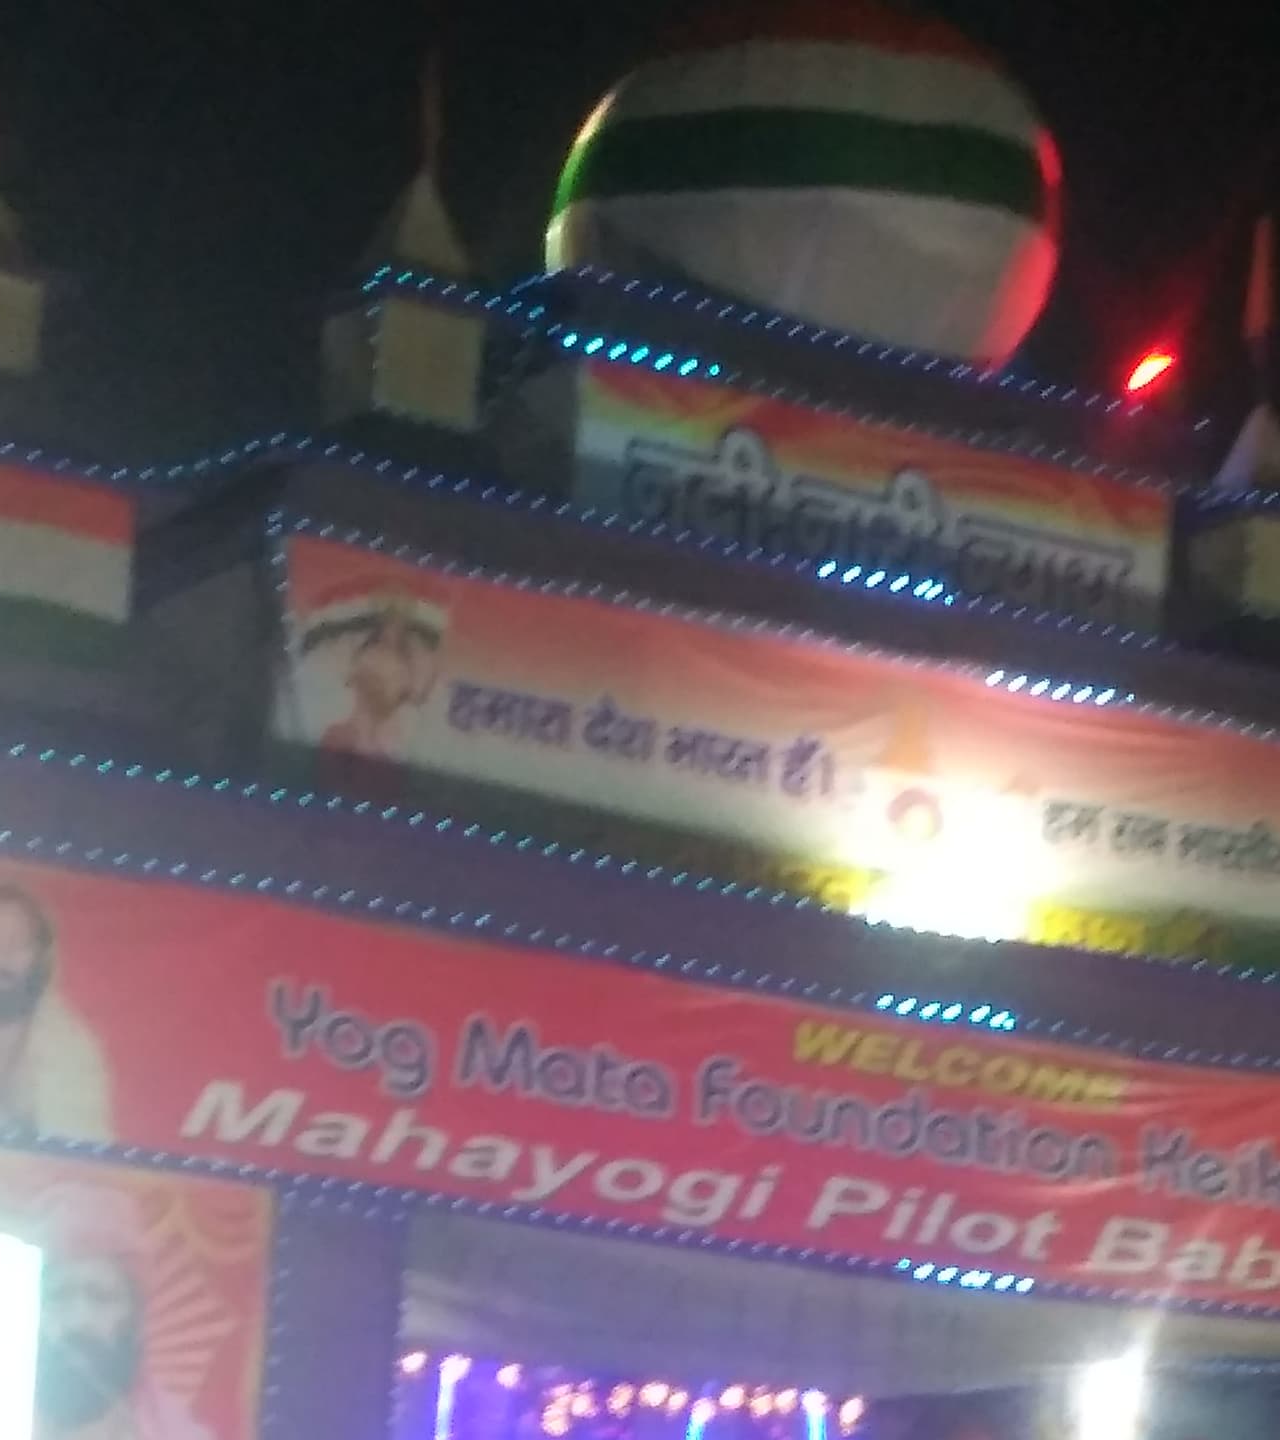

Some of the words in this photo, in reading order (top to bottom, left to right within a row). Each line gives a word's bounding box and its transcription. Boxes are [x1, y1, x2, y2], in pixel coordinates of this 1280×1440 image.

[582, 691, 656, 761] देश
[269, 976, 433, 1100] Yog
[455, 1016, 674, 1119] Mata
[694, 1057, 1114, 1182] Foundation
[180, 1080, 786, 1229] Mahayogi
[806, 1175, 1063, 1264] Pilot
